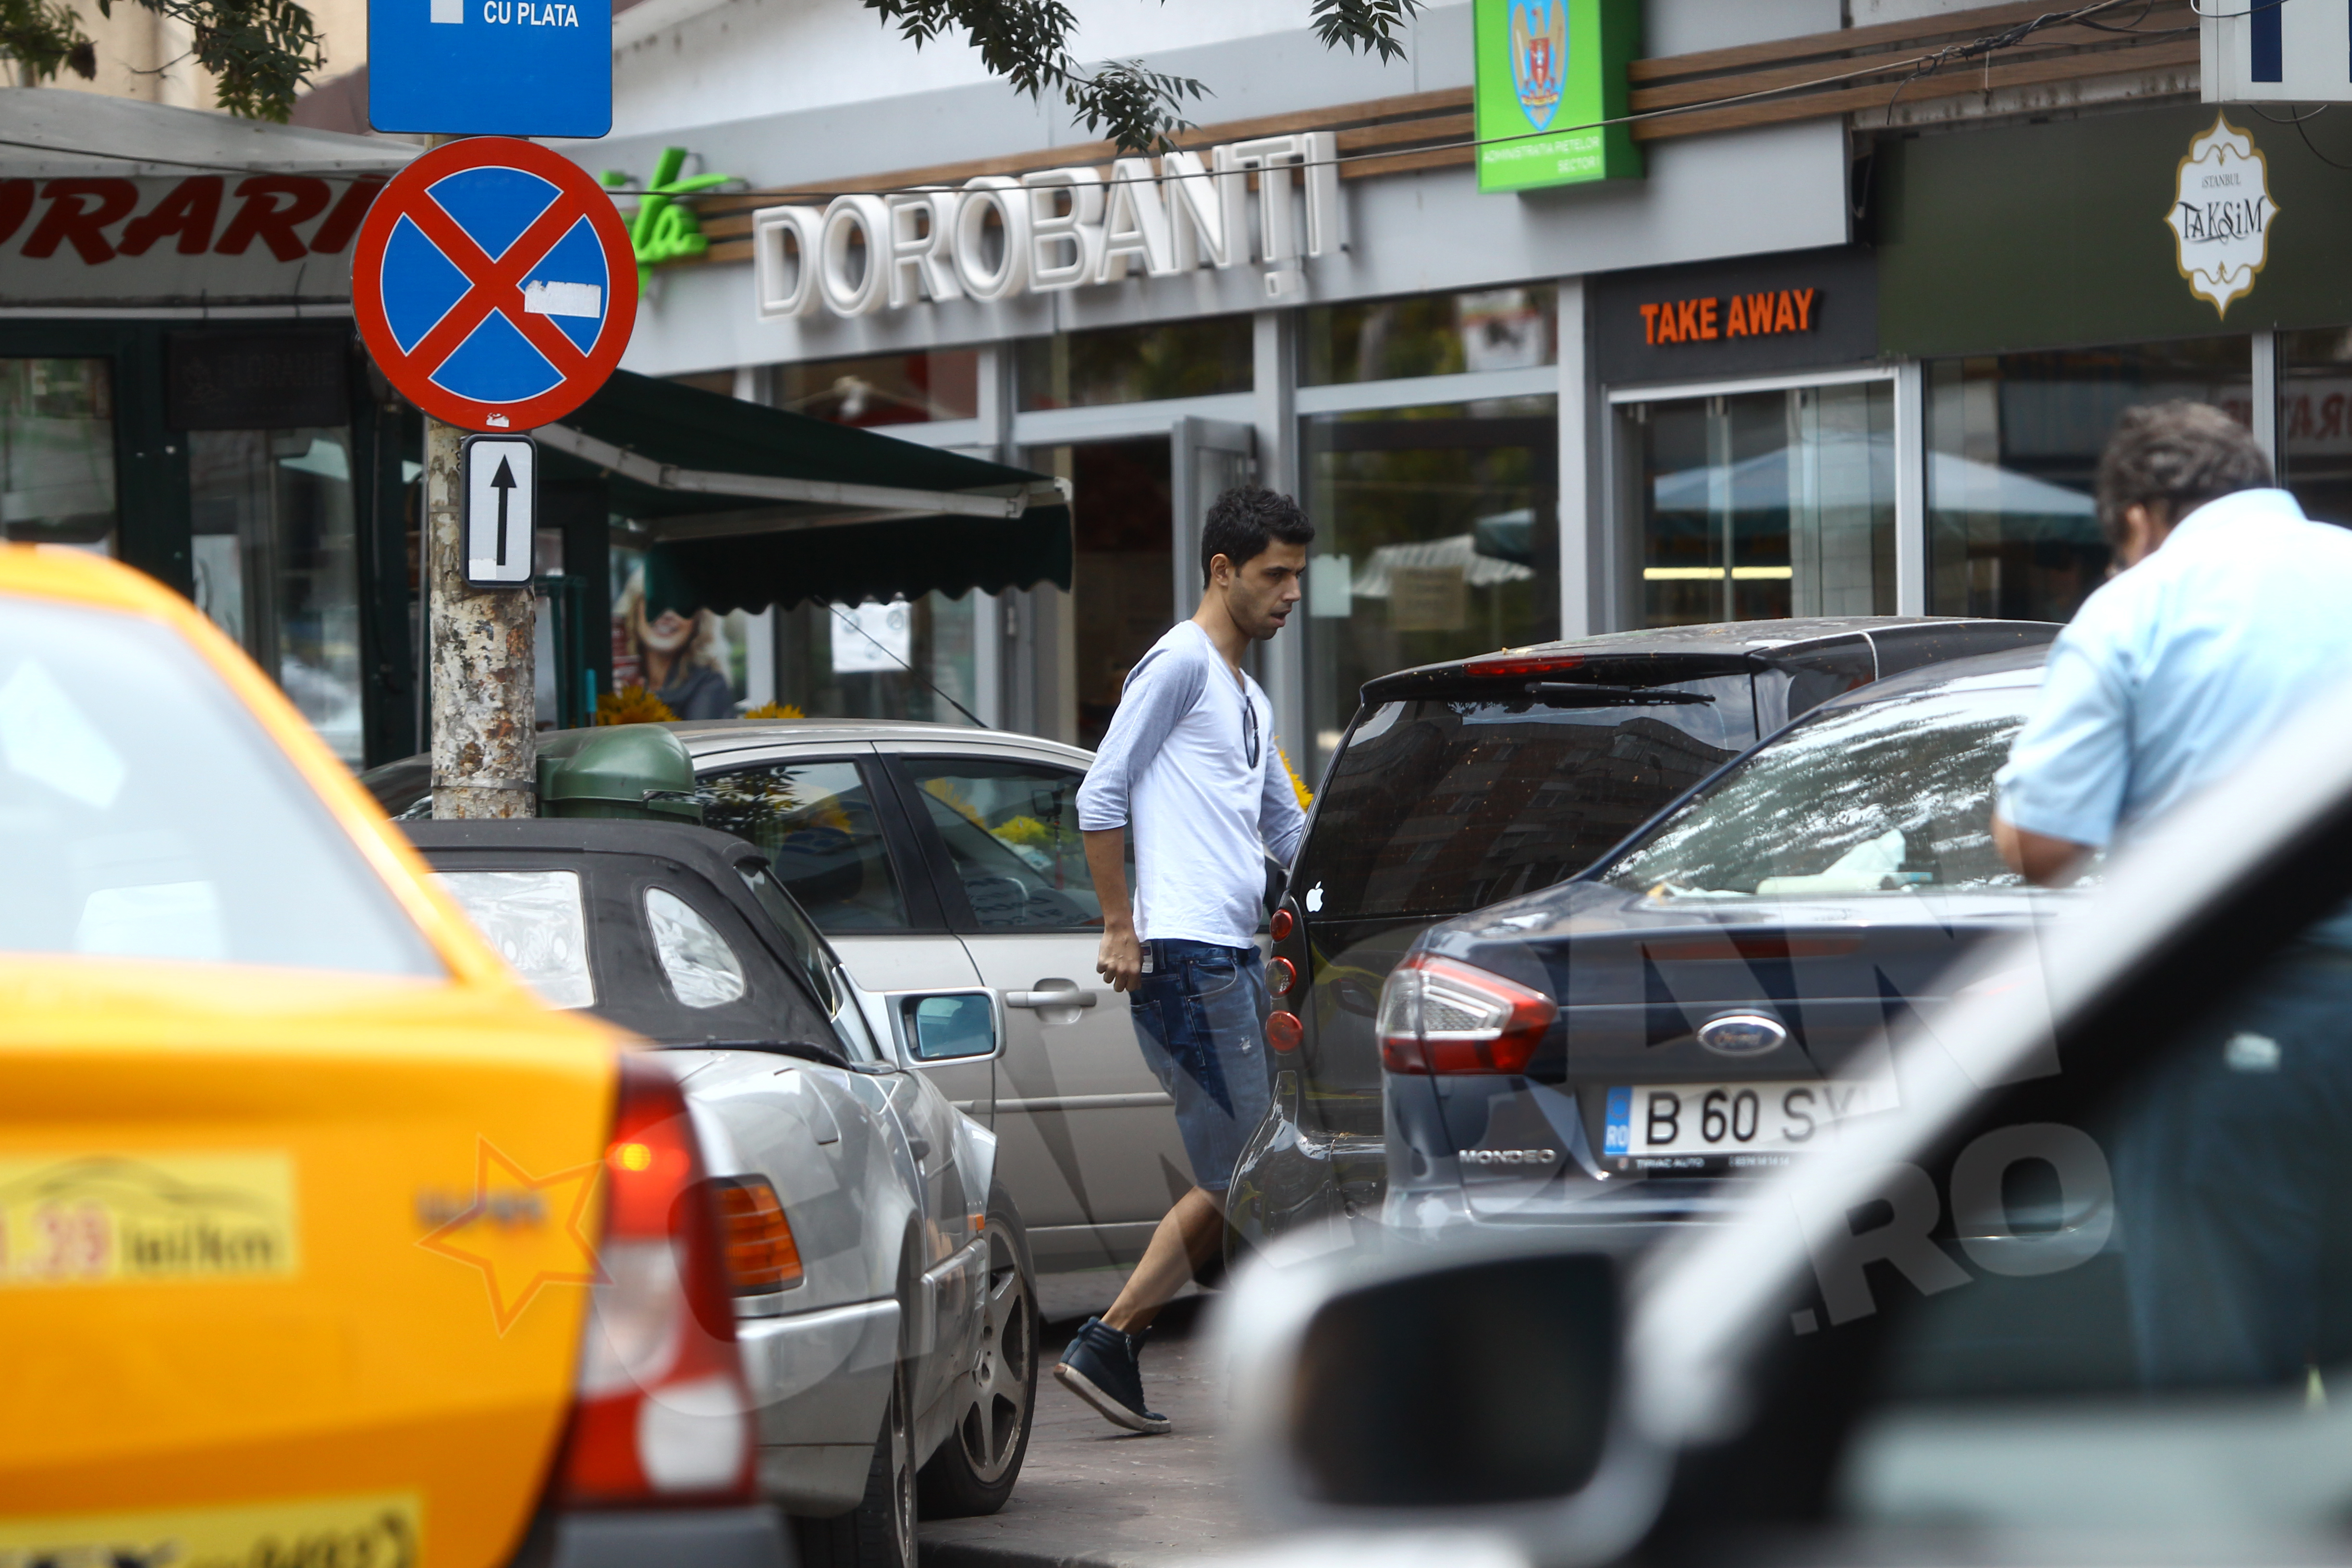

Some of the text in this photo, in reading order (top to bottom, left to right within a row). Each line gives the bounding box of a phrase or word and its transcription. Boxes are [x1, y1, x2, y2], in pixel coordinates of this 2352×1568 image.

[483, 0, 579, 27] CU PLATA
[1640, 287, 1814, 345] TAKE AWAY
[1647, 1087, 1870, 1146] B 60 SY
[1605, 1125, 1629, 1148] RO
[1458, 1149, 1556, 1164] MONDEO
